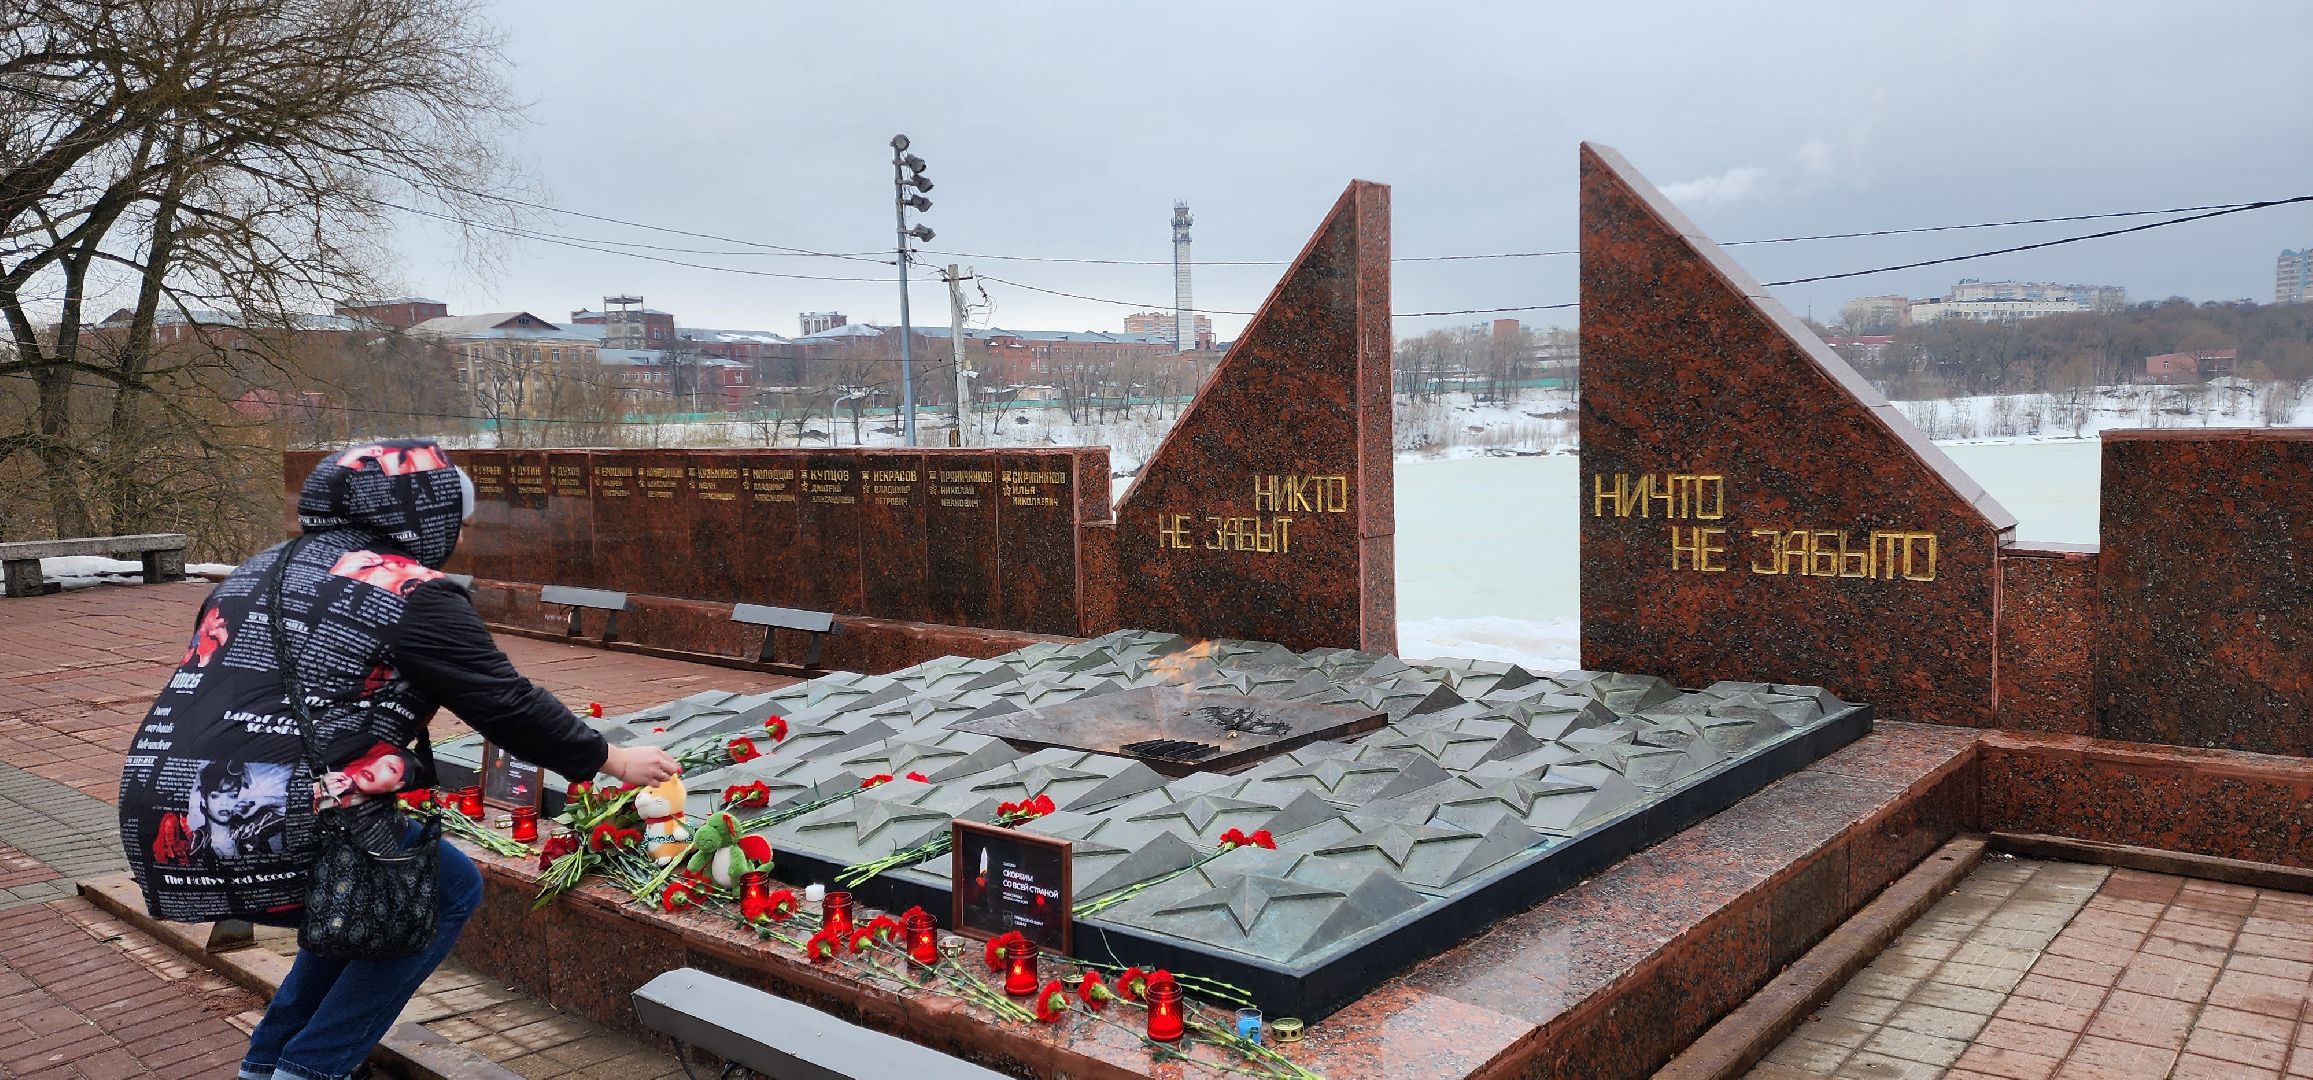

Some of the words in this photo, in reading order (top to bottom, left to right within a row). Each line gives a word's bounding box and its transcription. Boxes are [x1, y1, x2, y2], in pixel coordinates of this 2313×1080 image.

[752, 469, 794, 481] МОЛОДЦОВ
[810, 470, 849, 482] КУПЦОВ
[873, 470, 917, 482] НЕКРАСОВ
[1012, 470, 1066, 484] СКРИПНИКОВ
[1012, 486, 1036, 495] ИЛЬЯ
[1254, 475, 1347, 512] НИКТО
[1594, 473, 1724, 519] НИЧТО
[1159, 513, 1192, 549] НЕ
[1206, 515, 1293, 553] ЗАБЫТ
[1672, 525, 1727, 571] НЕ
[1751, 529, 1938, 581] ЗАБЫТО
[1003, 869, 1034, 882] СКОРБИМ
[1003, 880, 1012, 888] СО
[1012, 881, 1029, 892] ВСЕЙ
[1029, 885, 1059, 899] СТРАНОЙ
